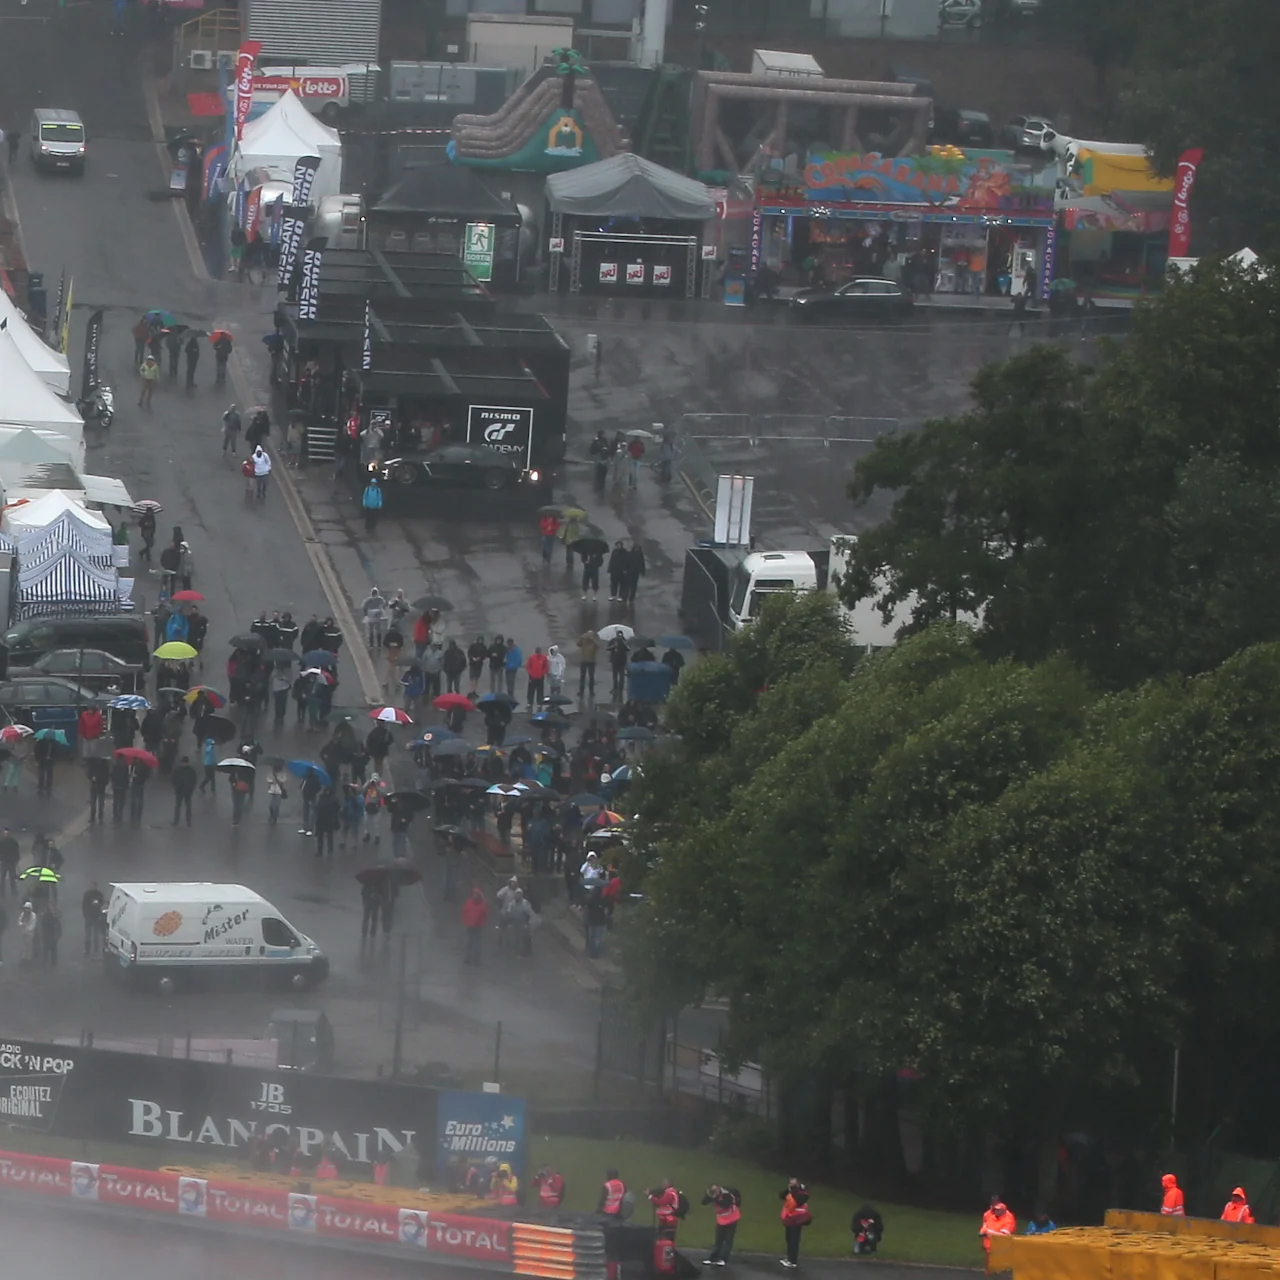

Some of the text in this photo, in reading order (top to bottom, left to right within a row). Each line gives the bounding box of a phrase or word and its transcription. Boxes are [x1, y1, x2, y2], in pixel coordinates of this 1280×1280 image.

[305, 80, 338, 94] Lotto
[299, 249, 314, 319] NISSAN
[203, 908, 250, 944] Mister
[42, 1057, 75, 1074] POP
[9, 1085, 52, 1102] ECOUTEZ
[250, 1101, 293, 1115] 1735
[444, 1119, 483, 1138] Euro
[450, 1134, 516, 1154] Millions
[100, 1173, 175, 1204] TOTAL
[207, 1189, 289, 1220] TOTAL
[318, 1205, 395, 1237] TOTAL
[431, 1221, 506, 1252] TOTAL
